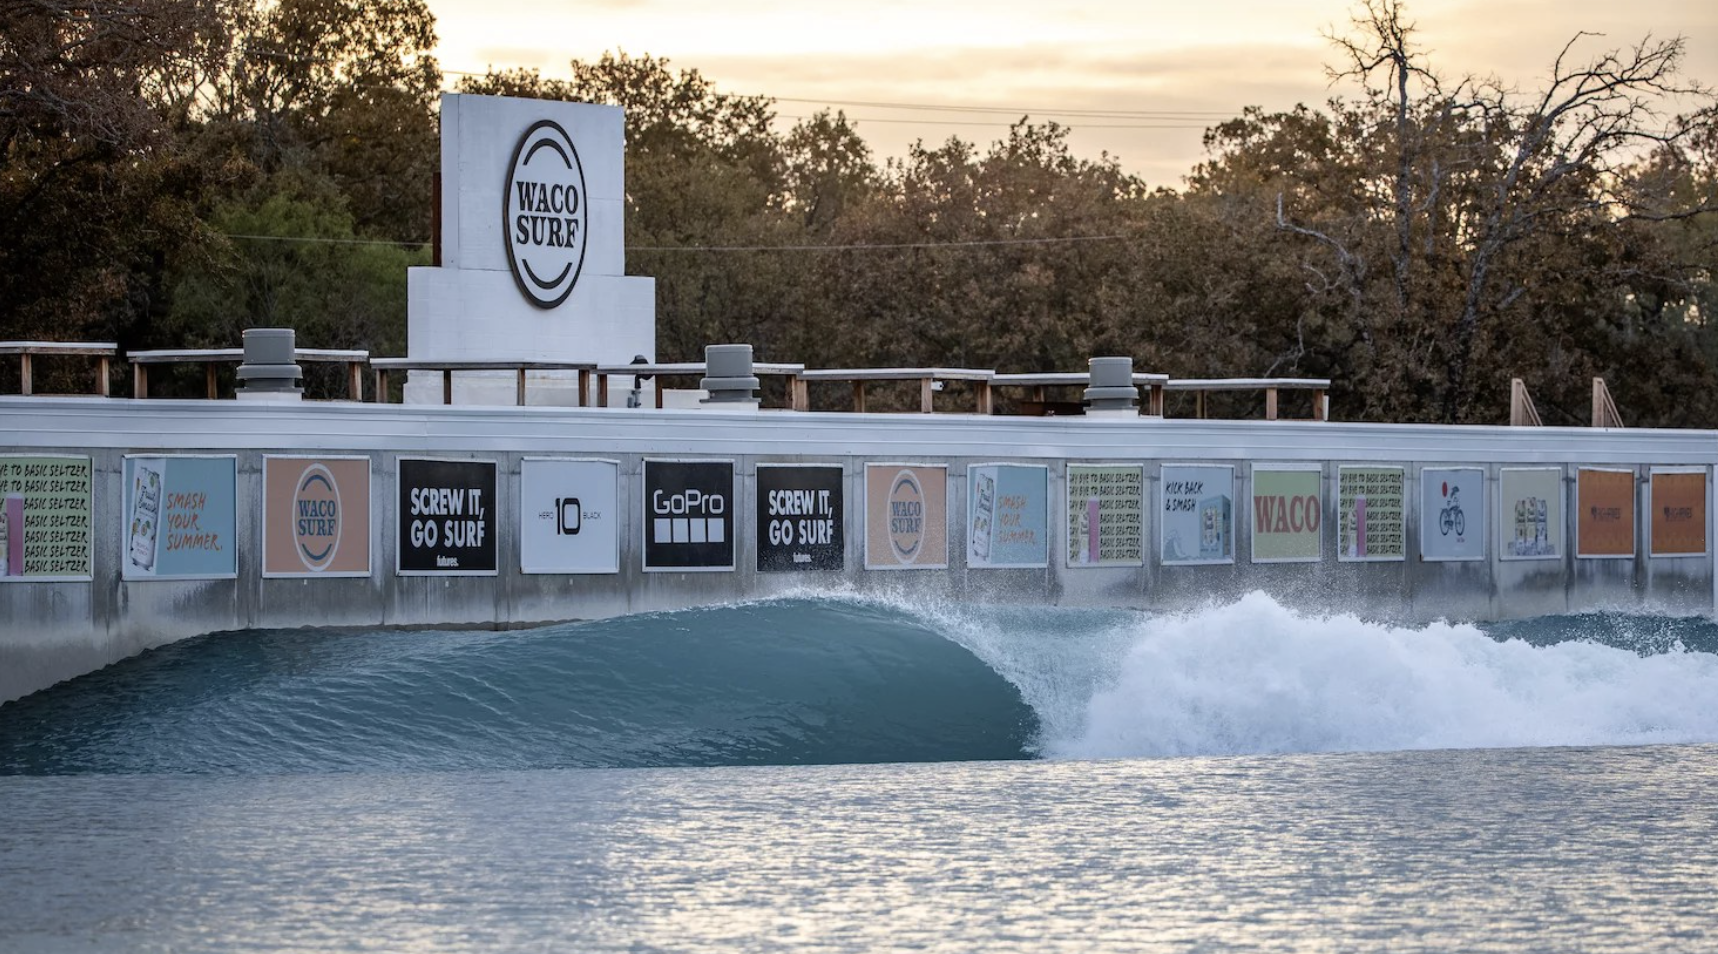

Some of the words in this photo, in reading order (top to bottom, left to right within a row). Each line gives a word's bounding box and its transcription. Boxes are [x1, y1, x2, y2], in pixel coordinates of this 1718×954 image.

[516, 180, 579, 215] WACO
[516, 214, 579, 249] SURF
[11, 464, 22, 476] TO
[24, 464, 47, 478] BASIC
[50, 464, 88, 478] SELTZER
[11, 480, 22, 492] TO
[24, 480, 47, 493] BASIC
[50, 480, 88, 493] SELTZER
[1166, 482, 1183, 495] KICK
[1185, 481, 1203, 495] BACK
[24, 498, 46, 510] BASIC
[49, 498, 87, 510] SELTZER
[166, 492, 206, 510] SMASH
[298, 500, 336, 517] WACO
[410, 488, 464, 516] SCREW
[468, 488, 485, 520] IT,
[653, 489, 724, 514] GoPro
[768, 490, 816, 516] SCREW
[818, 490, 833, 519] IT,
[891, 501, 921, 516] WACO
[1166, 498, 1170, 511] &
[1172, 498, 1196, 512] SMASH
[24, 516, 47, 528] BASIC
[50, 516, 88, 528] SELTZER
[167, 512, 200, 532] YOUR
[555, 498, 580, 535] 10
[1254, 495, 1320, 534] WACO
[298, 519, 336, 536] SURF
[410, 520, 438, 548] GO
[444, 520, 485, 548] SURF
[768, 520, 793, 546] GO
[799, 520, 834, 544] SURF
[891, 518, 921, 534] SURF
[24, 531, 47, 544] BASIC
[50, 531, 88, 544] SELTZER
[166, 531, 222, 551] SUMMER.
[24, 546, 47, 558] BASIC
[50, 546, 88, 558] SELTZER
[24, 560, 47, 573] BASIC
[50, 560, 88, 573] SELTZER
